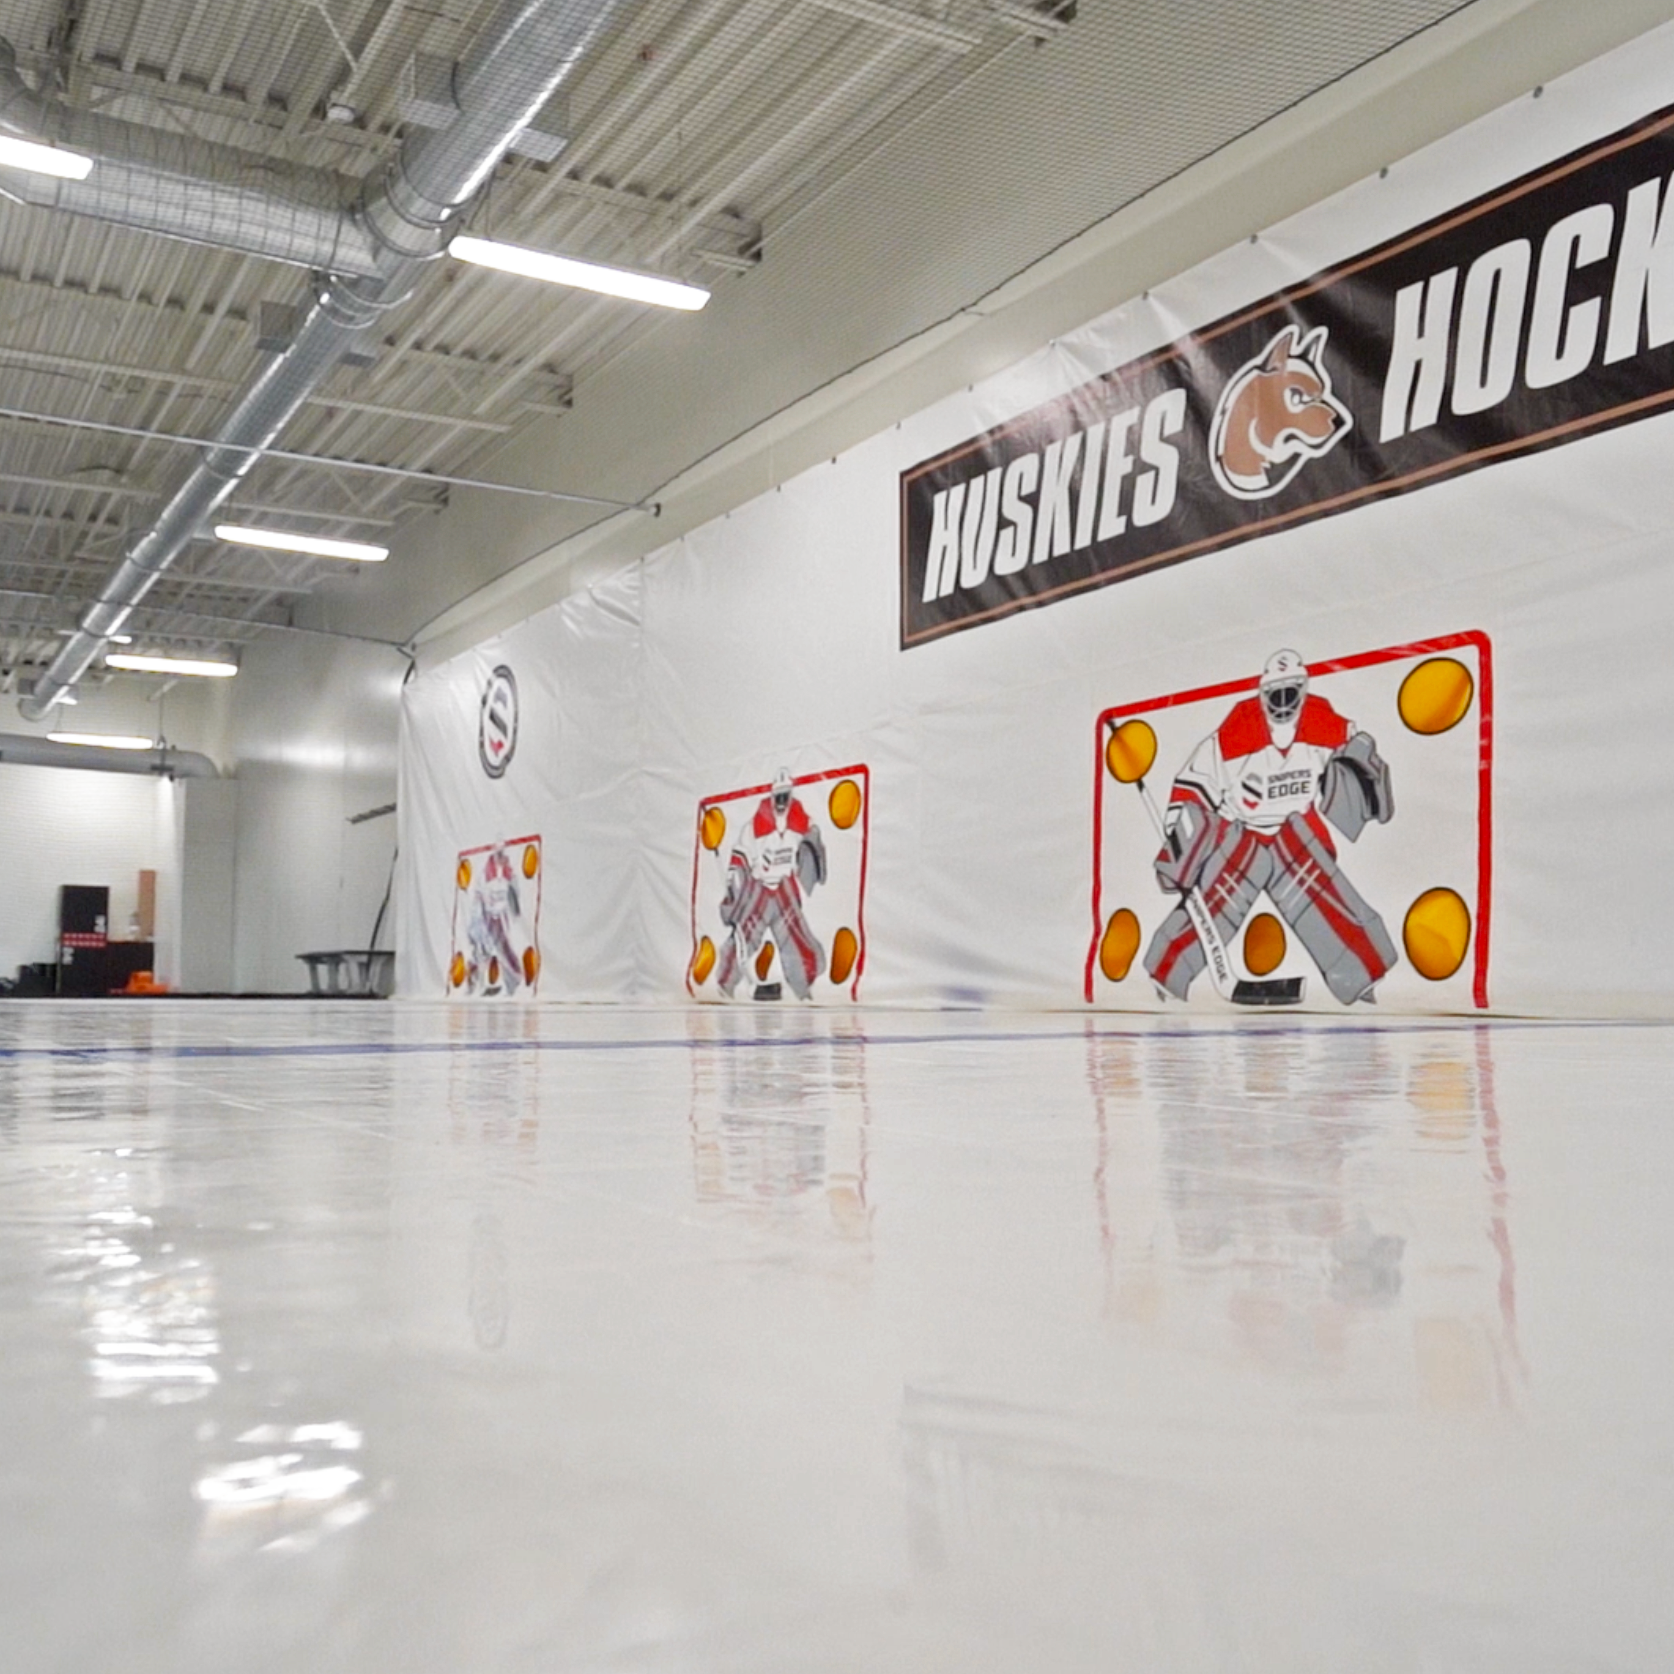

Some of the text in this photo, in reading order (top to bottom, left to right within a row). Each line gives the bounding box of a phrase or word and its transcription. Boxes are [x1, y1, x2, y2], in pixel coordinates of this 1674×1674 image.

[922, 170, 1674, 603] HUSKIES HOCK
[1268, 781, 1310, 799] EDGE
